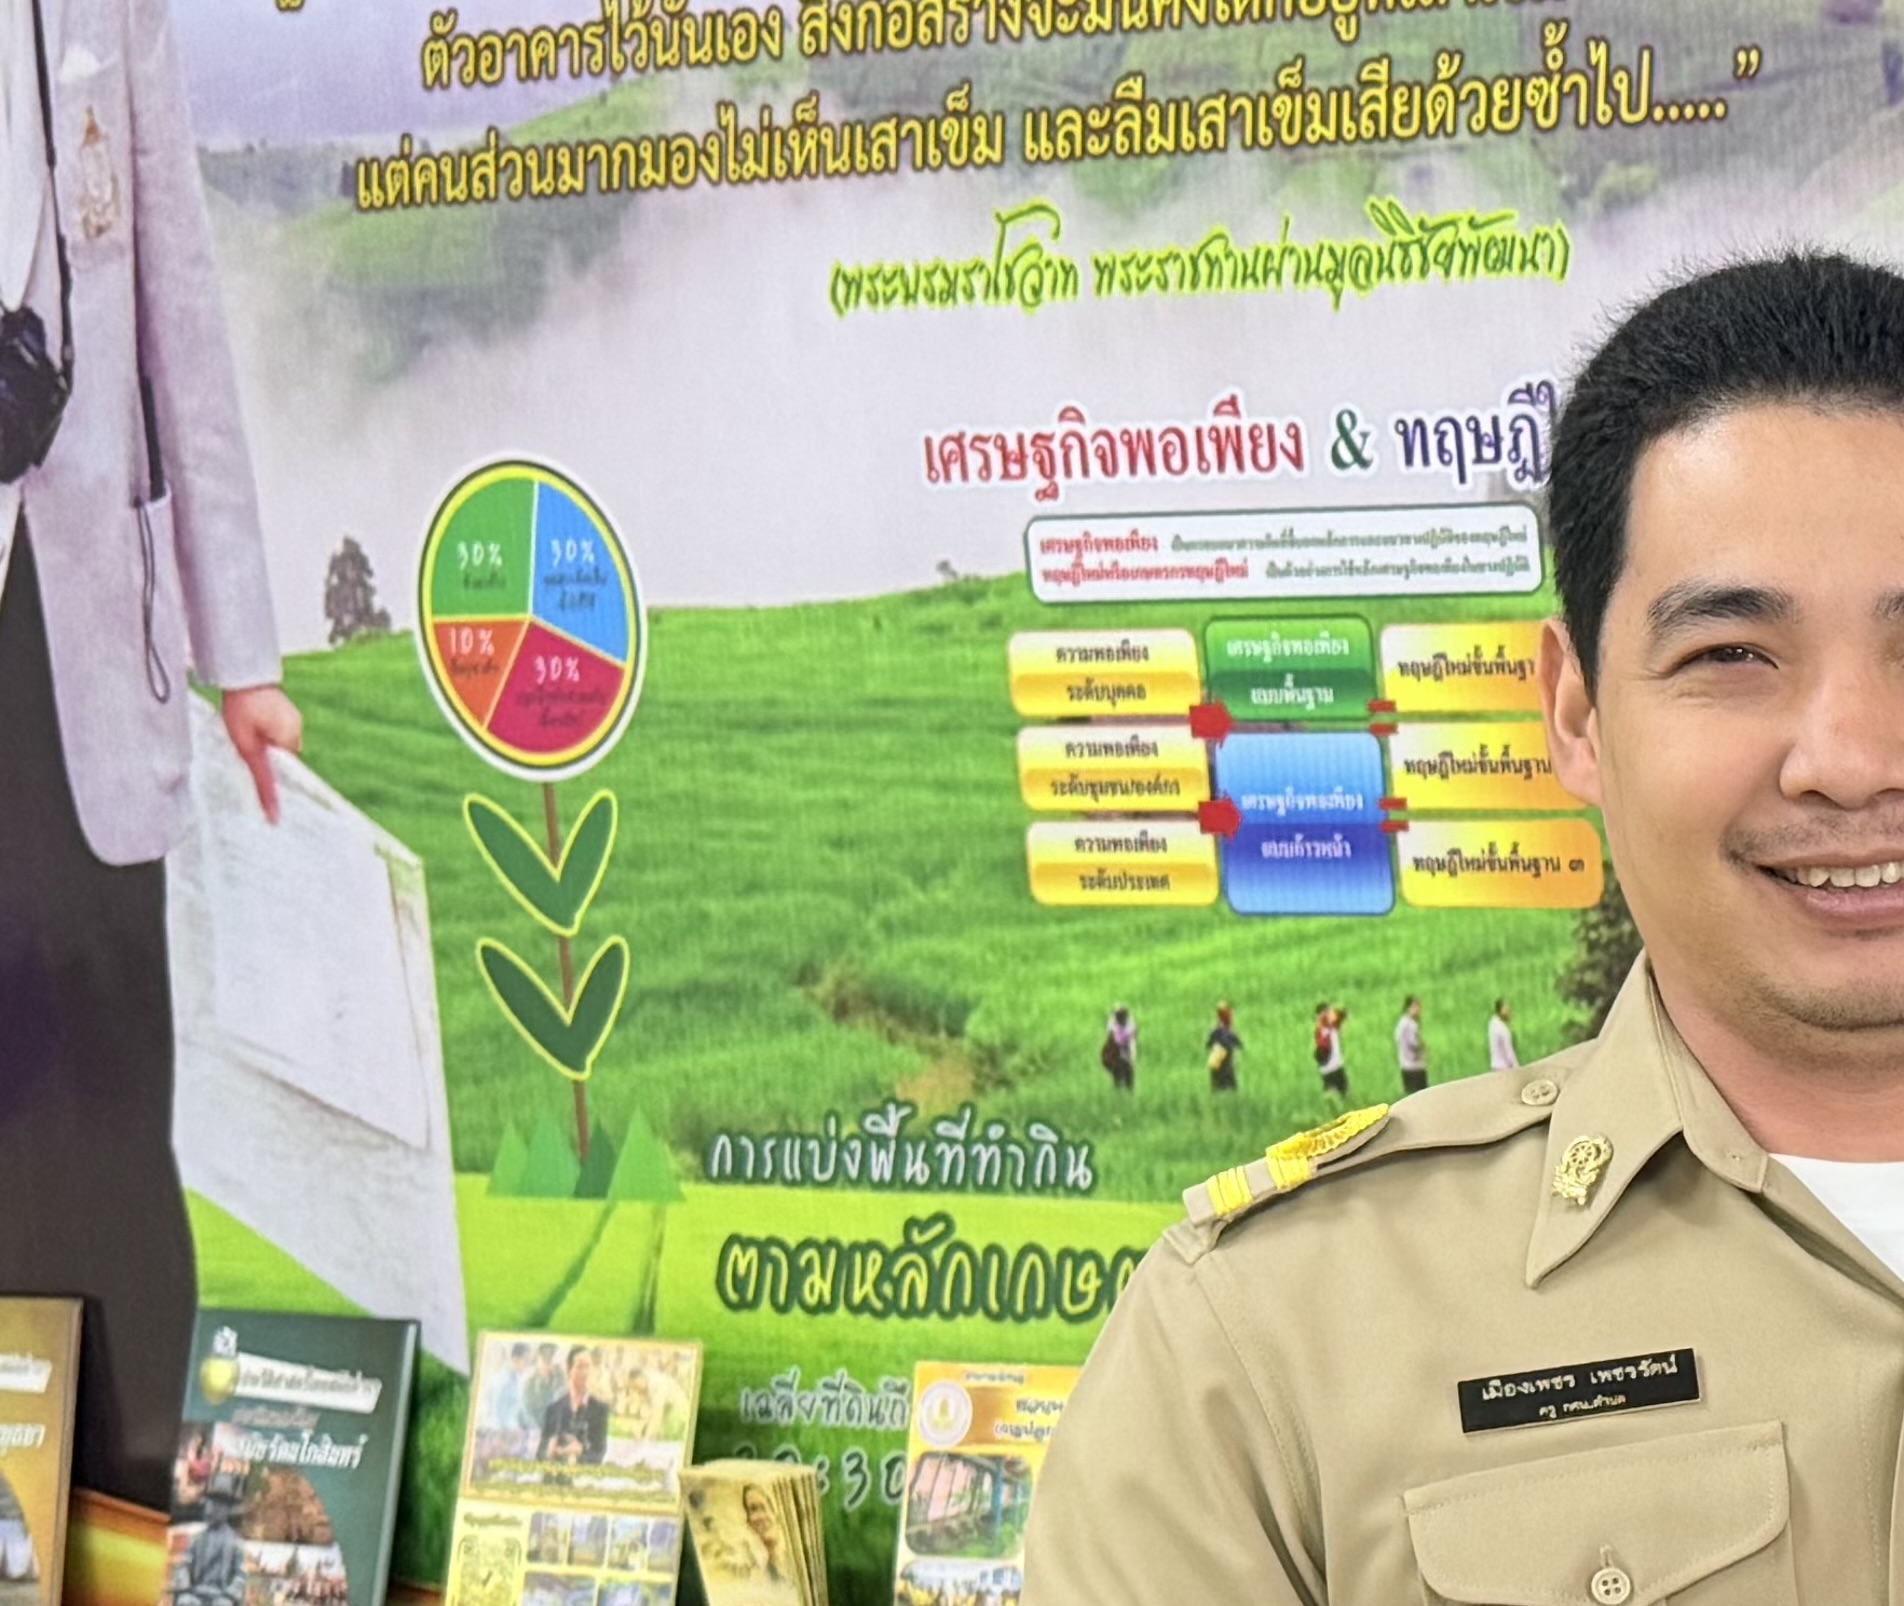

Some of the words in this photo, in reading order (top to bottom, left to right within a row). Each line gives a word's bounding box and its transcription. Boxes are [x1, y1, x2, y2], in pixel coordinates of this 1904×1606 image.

[354, 85, 1004, 212] แต่คนส่วนมากมองไม่เห็นเสาเข็ม
[924, 391, 1307, 500] เศรษฐกิจพอเพียง
[1329, 408, 1375, 472] &
[708, 1102, 1095, 1192] การแบ่งพื้นที่ทำกิน
